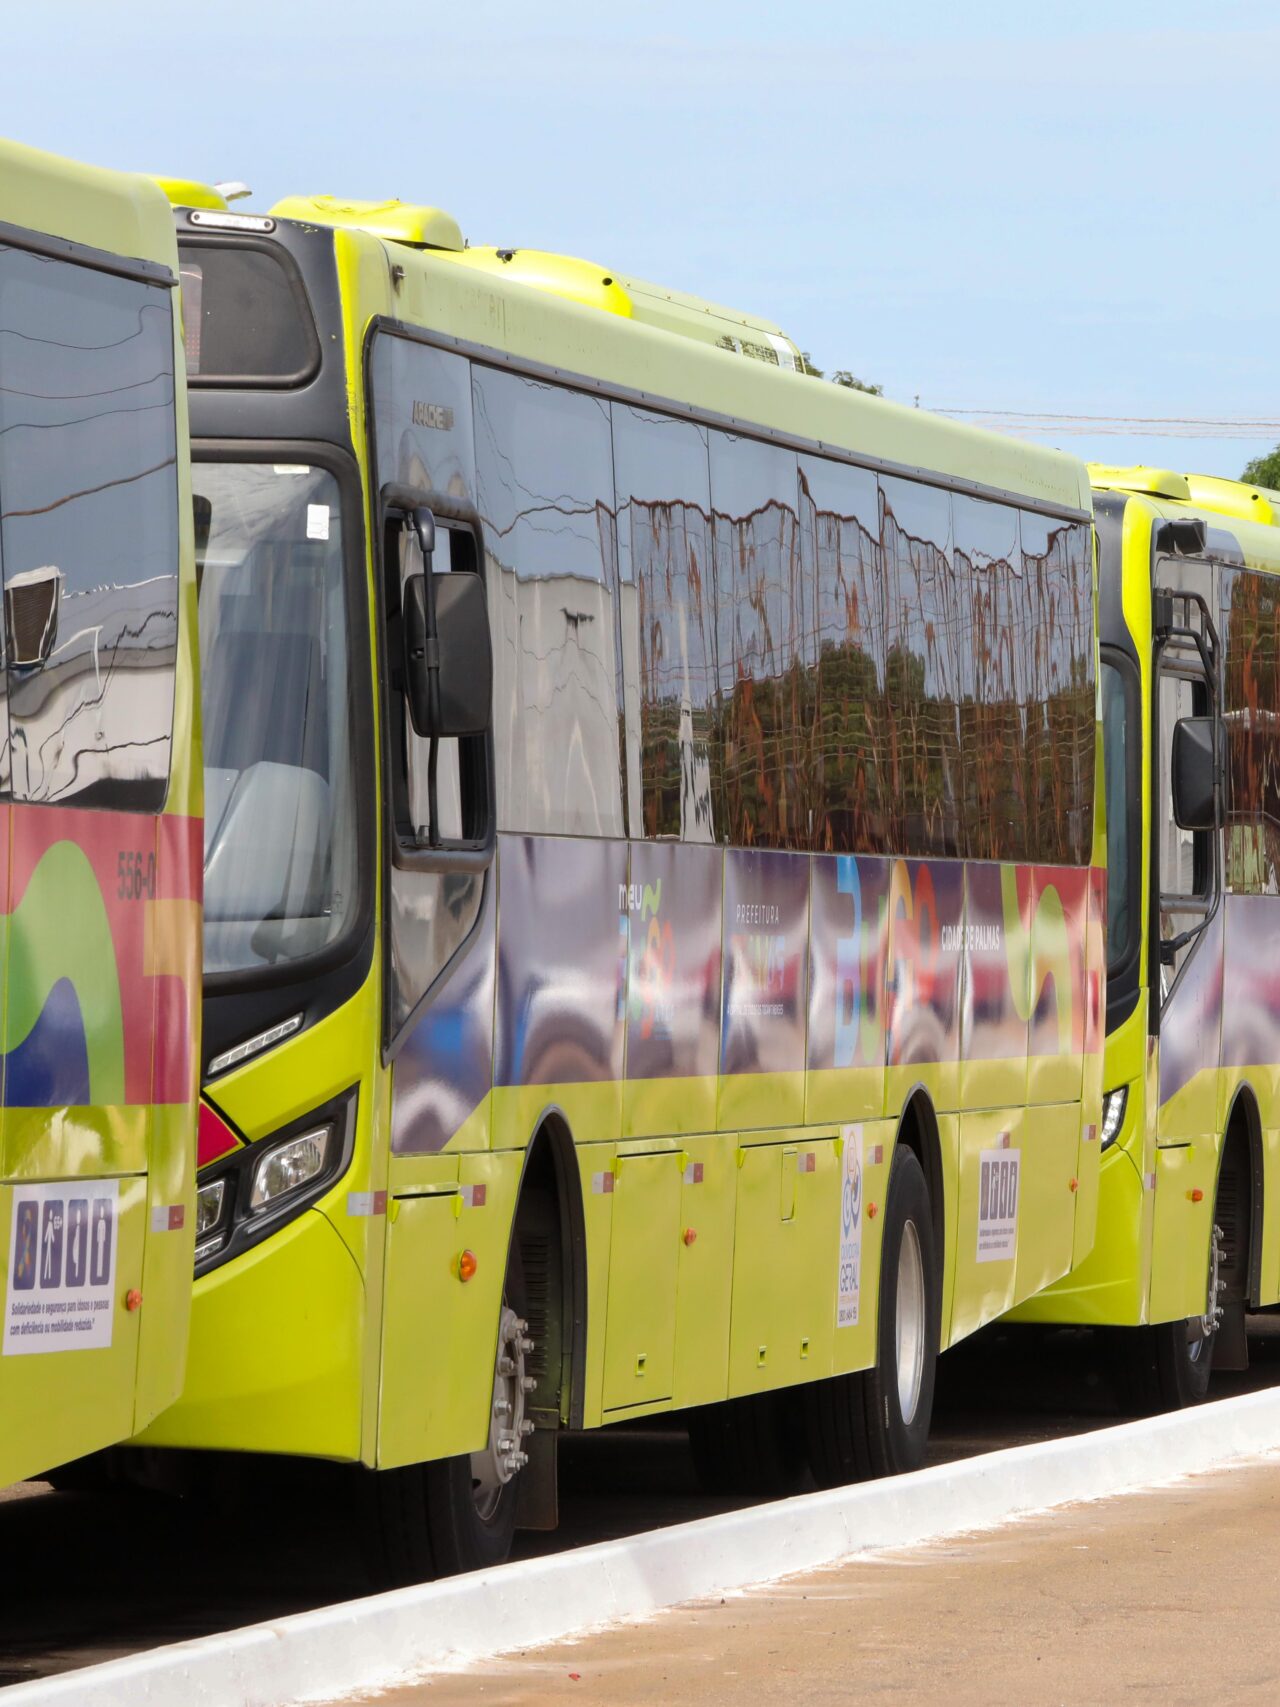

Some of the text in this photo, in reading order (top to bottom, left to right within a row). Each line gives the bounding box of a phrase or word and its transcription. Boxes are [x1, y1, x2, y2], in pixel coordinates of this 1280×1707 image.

[736, 904, 779, 924] PREFEITURA
[941, 924, 1000, 951] CIDADE DE PALMAS
